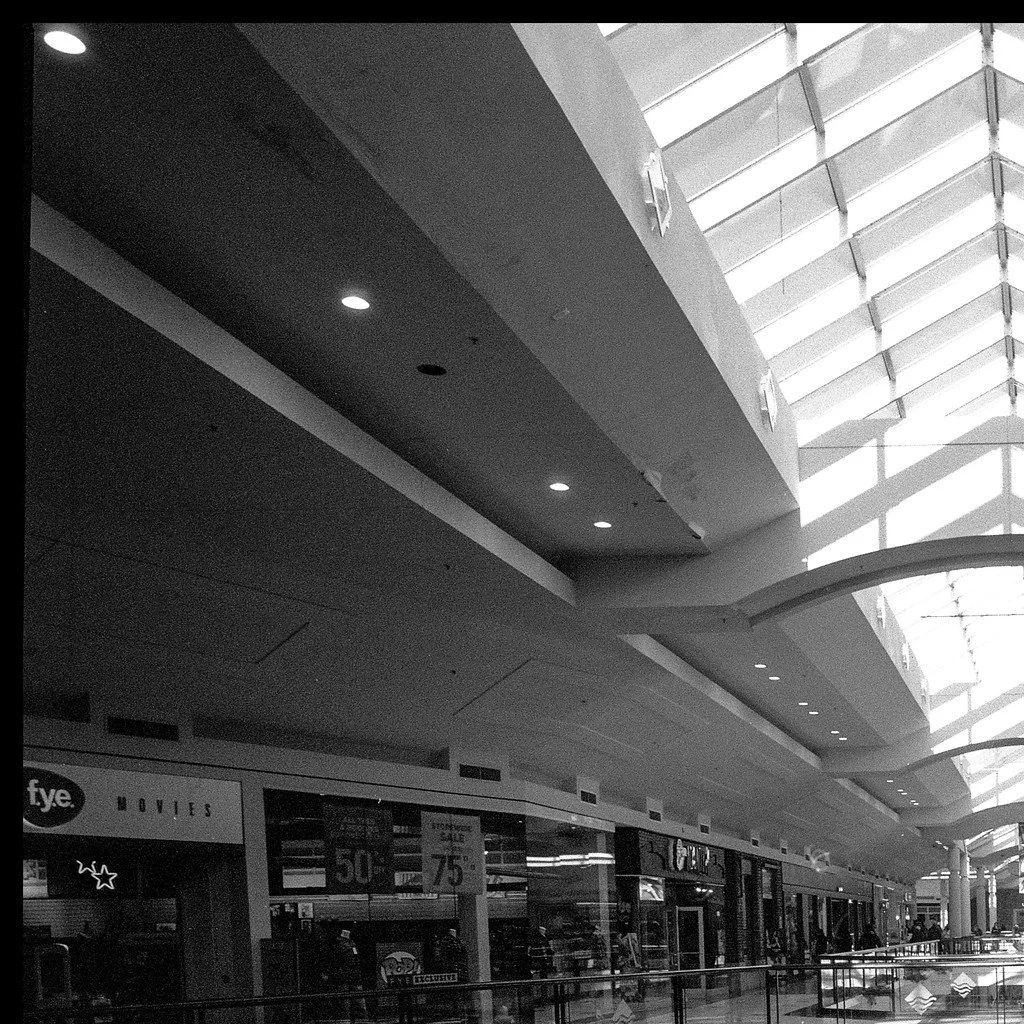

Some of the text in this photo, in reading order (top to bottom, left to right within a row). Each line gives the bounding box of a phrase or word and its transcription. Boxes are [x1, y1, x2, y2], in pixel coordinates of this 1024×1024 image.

[116, 796, 212, 817] MOVIES
[440, 832, 465, 844] SALE
[414, 974, 456, 984] EXCLUSIVE
